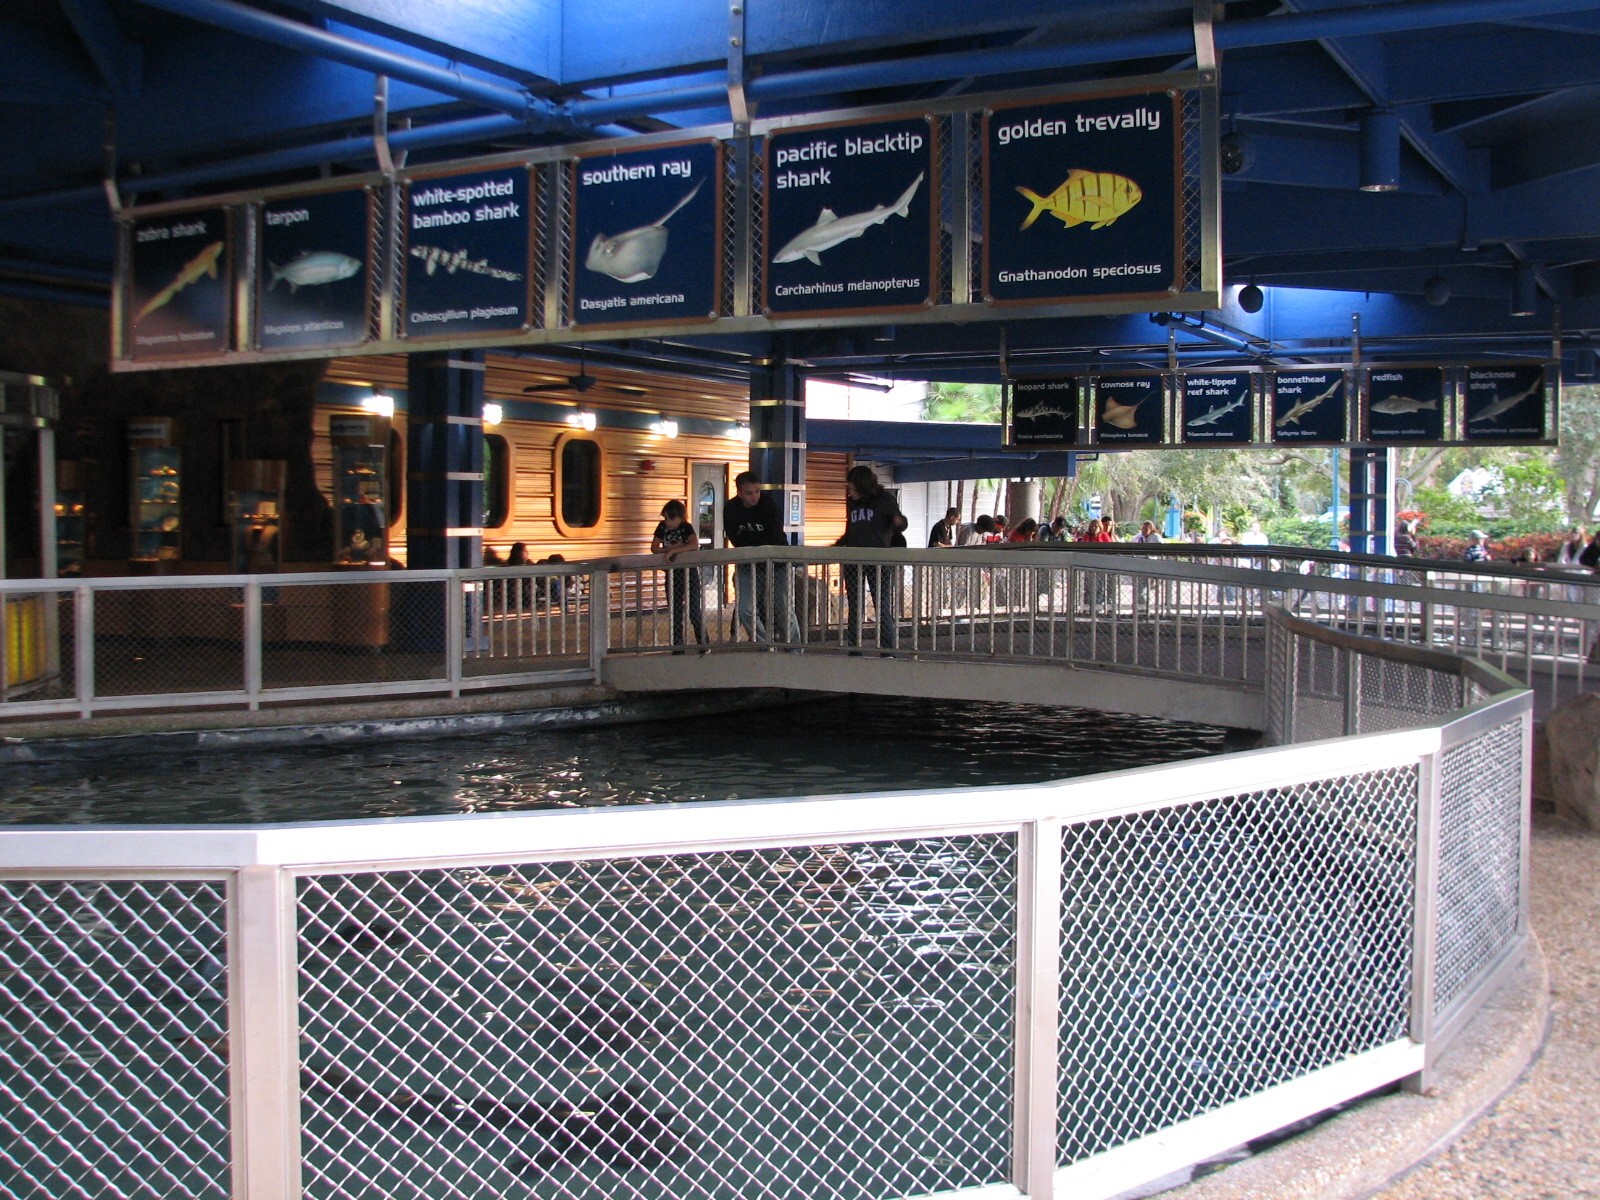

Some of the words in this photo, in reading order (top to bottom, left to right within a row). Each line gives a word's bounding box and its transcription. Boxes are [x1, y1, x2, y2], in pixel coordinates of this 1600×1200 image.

[998, 119, 1067, 145] golden
[1075, 107, 1161, 132] trevally
[776, 141, 838, 168] pacific
[845, 131, 923, 154] blacktip
[582, 165, 656, 186] southern
[662, 160, 692, 178] ray
[776, 167, 832, 190] shark
[412, 179, 514, 207] white-spotted
[265, 208, 310, 227] tarpon
[412, 210, 471, 229] bamboo
[475, 201, 520, 221] shark
[171, 220, 207, 238] shark
[998, 267, 1088, 283] Gnathanodon
[1092, 263, 1162, 280] speciosus
[775, 282, 844, 297] Carcharhinus
[847, 277, 921, 293] melanopterus
[580, 296, 628, 312] Dasyatis
[630, 293, 685, 307] americana
[471, 305, 519, 320] plagiosum
[1186, 377, 1237, 387] white-tipped
[1277, 375, 1326, 384] bonnethead
[1371, 373, 1403, 381] redfish
[1469, 371, 1516, 380] blacknose
[1017, 383, 1046, 392] leopard
[1047, 381, 1070, 391] shark
[1136, 381, 1152, 389] ray
[1186, 388, 1204, 396] reef
[1205, 387, 1230, 396] shark
[1277, 386, 1302, 394] shark
[1469, 382, 1497, 390] shark
[850, 508, 874, 523] GAP
